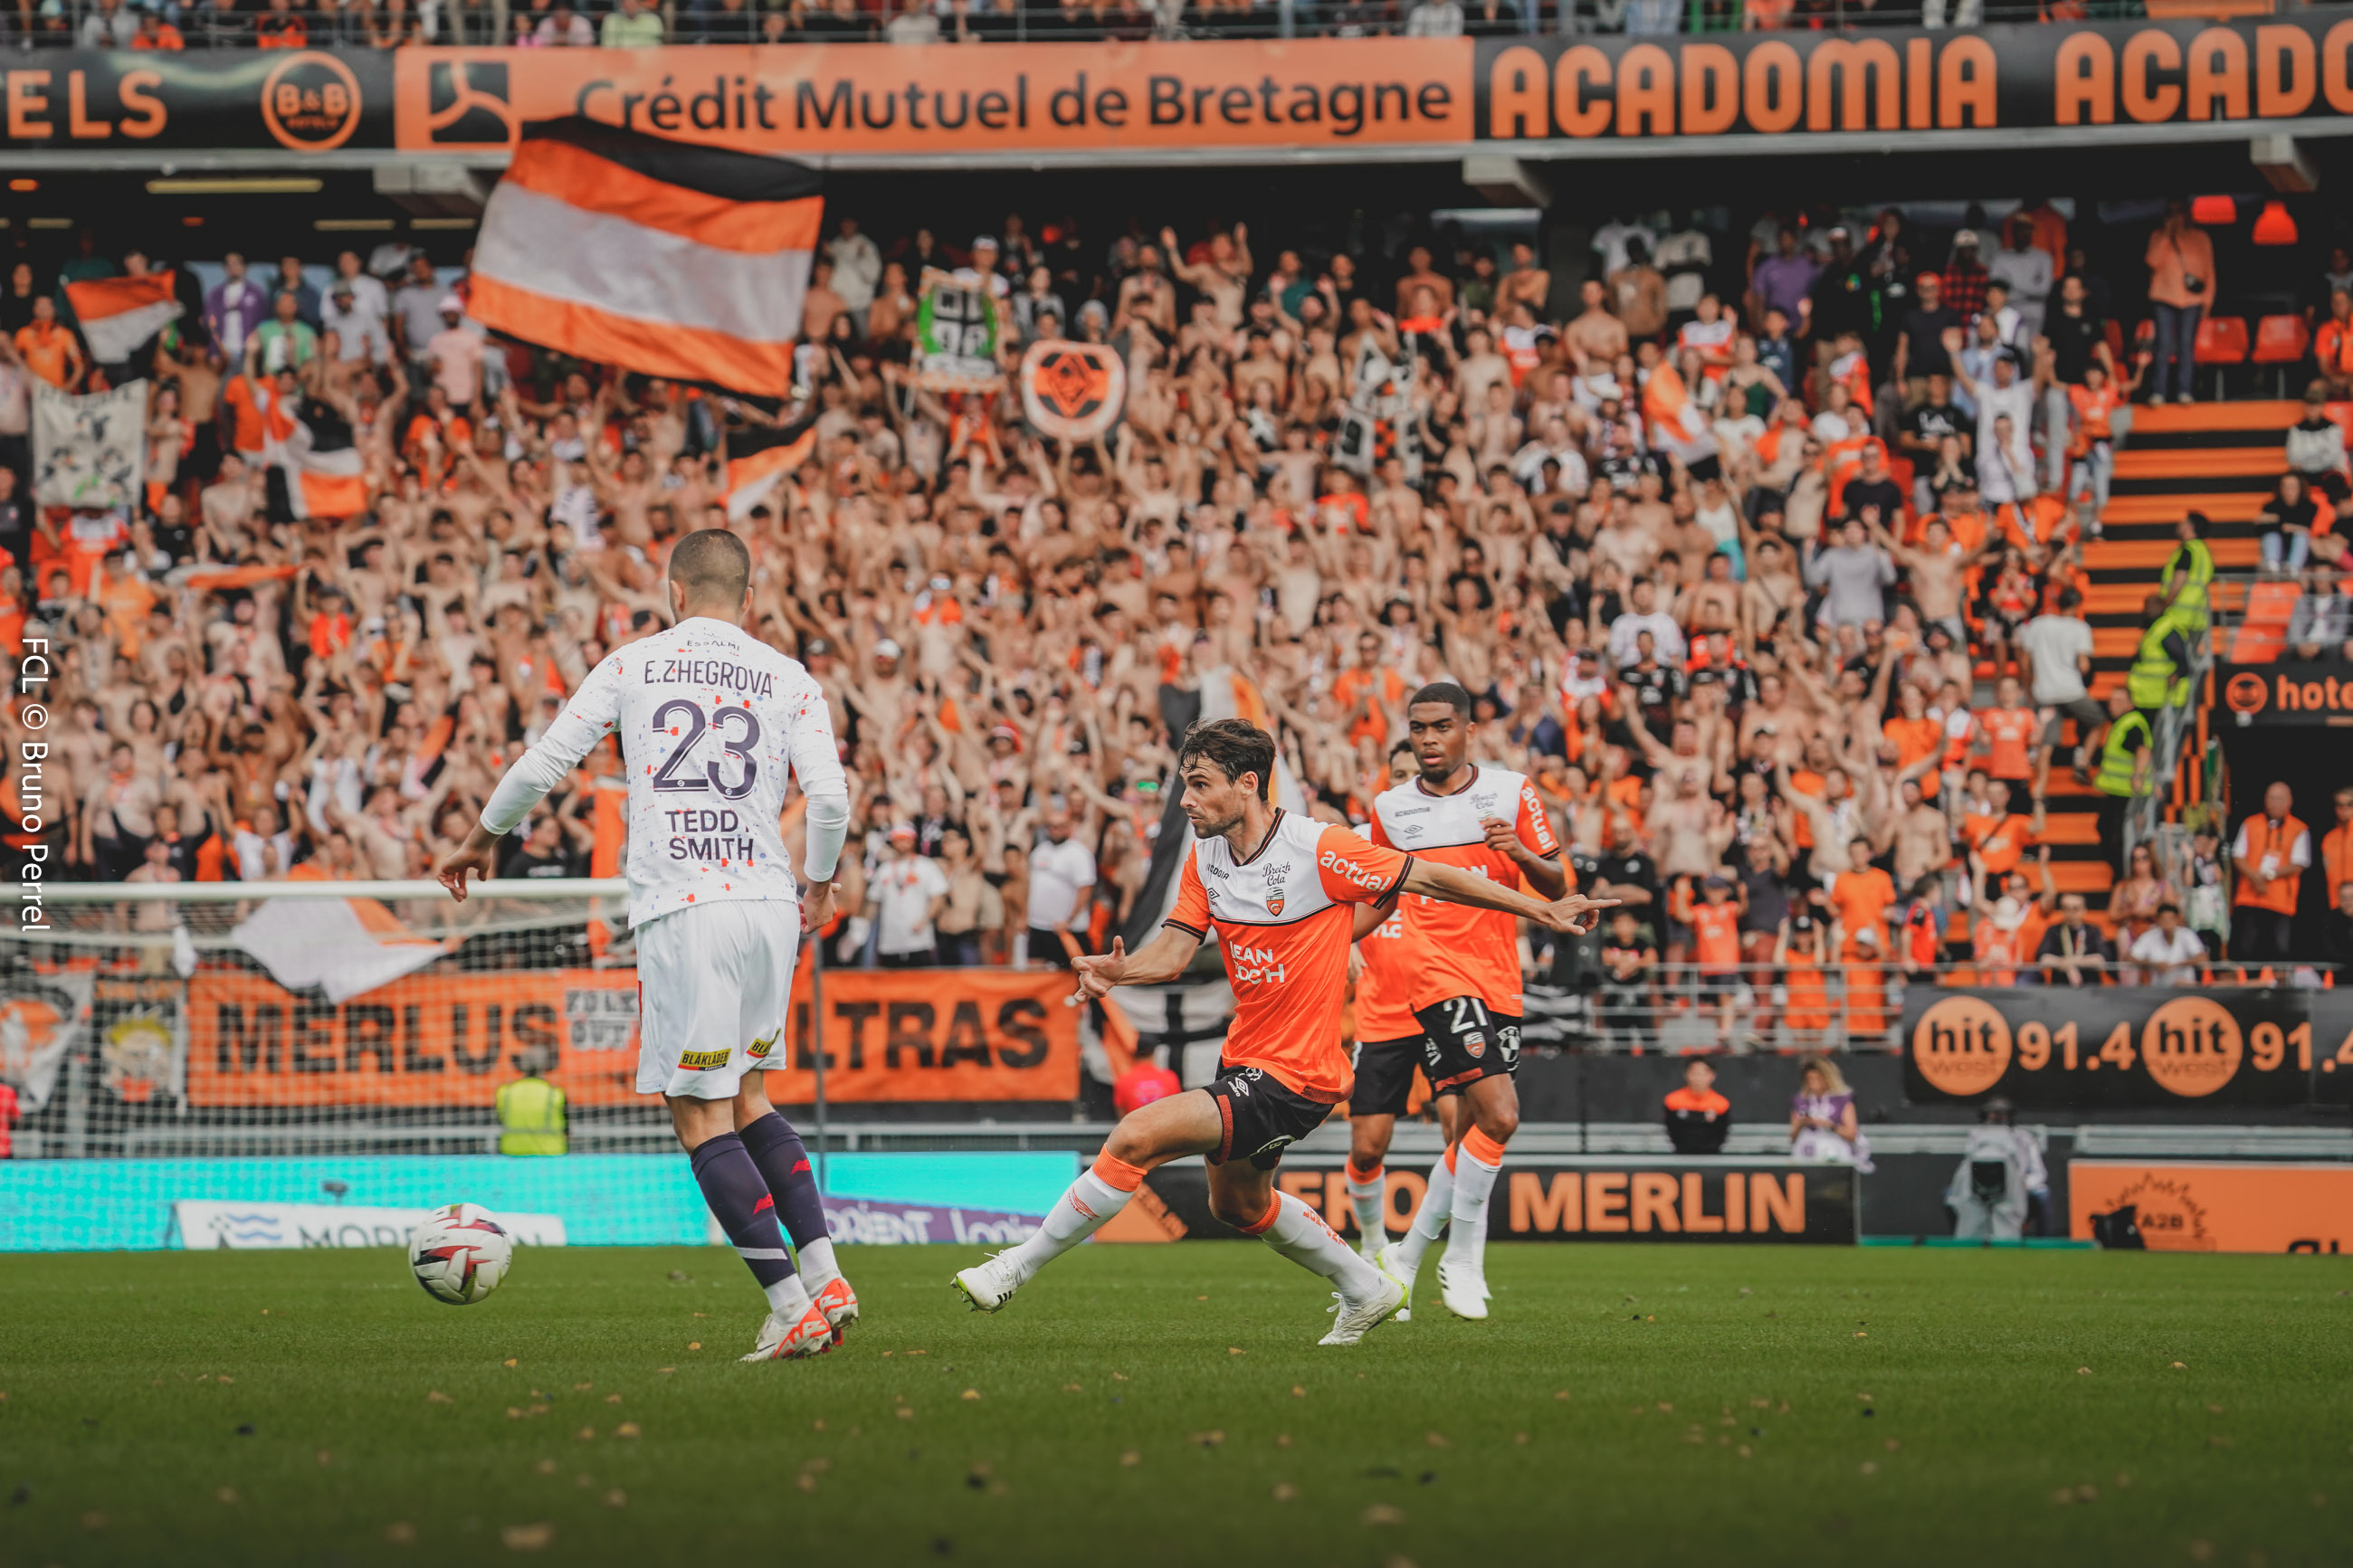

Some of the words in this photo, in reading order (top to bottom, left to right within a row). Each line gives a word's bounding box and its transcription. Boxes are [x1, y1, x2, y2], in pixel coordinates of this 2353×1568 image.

[6, 69, 168, 139] ELS
[277, 83, 348, 117] B&B
[576, 75, 776, 129] Crédit
[795, 72, 1027, 129] Mutuel
[1050, 71, 1129, 128] de
[1148, 73, 1452, 137] Bretagne
[1490, 33, 1997, 138] ACADOMIA
[644, 659, 773, 699] E.ZHEGROVA
[652, 698, 760, 801] 23
[664, 809, 750, 833] TEDD
[1521, 786, 1554, 850] actual
[668, 837, 754, 861] SMITH
[1262, 861, 1291, 878] Breizh
[1267, 874, 1286, 887] Cola
[1319, 850, 1393, 892] actual
[1234, 963, 1285, 985] OC'H
[1443, 996, 1489, 1034] 21
[217, 1002, 560, 1075] MERLUS
[1930, 1016, 1996, 1053] hit
[2016, 1021, 2138, 1072] 91.4
[2158, 1017, 2226, 1054] hit
[1509, 1172, 1806, 1234] MERLIN
